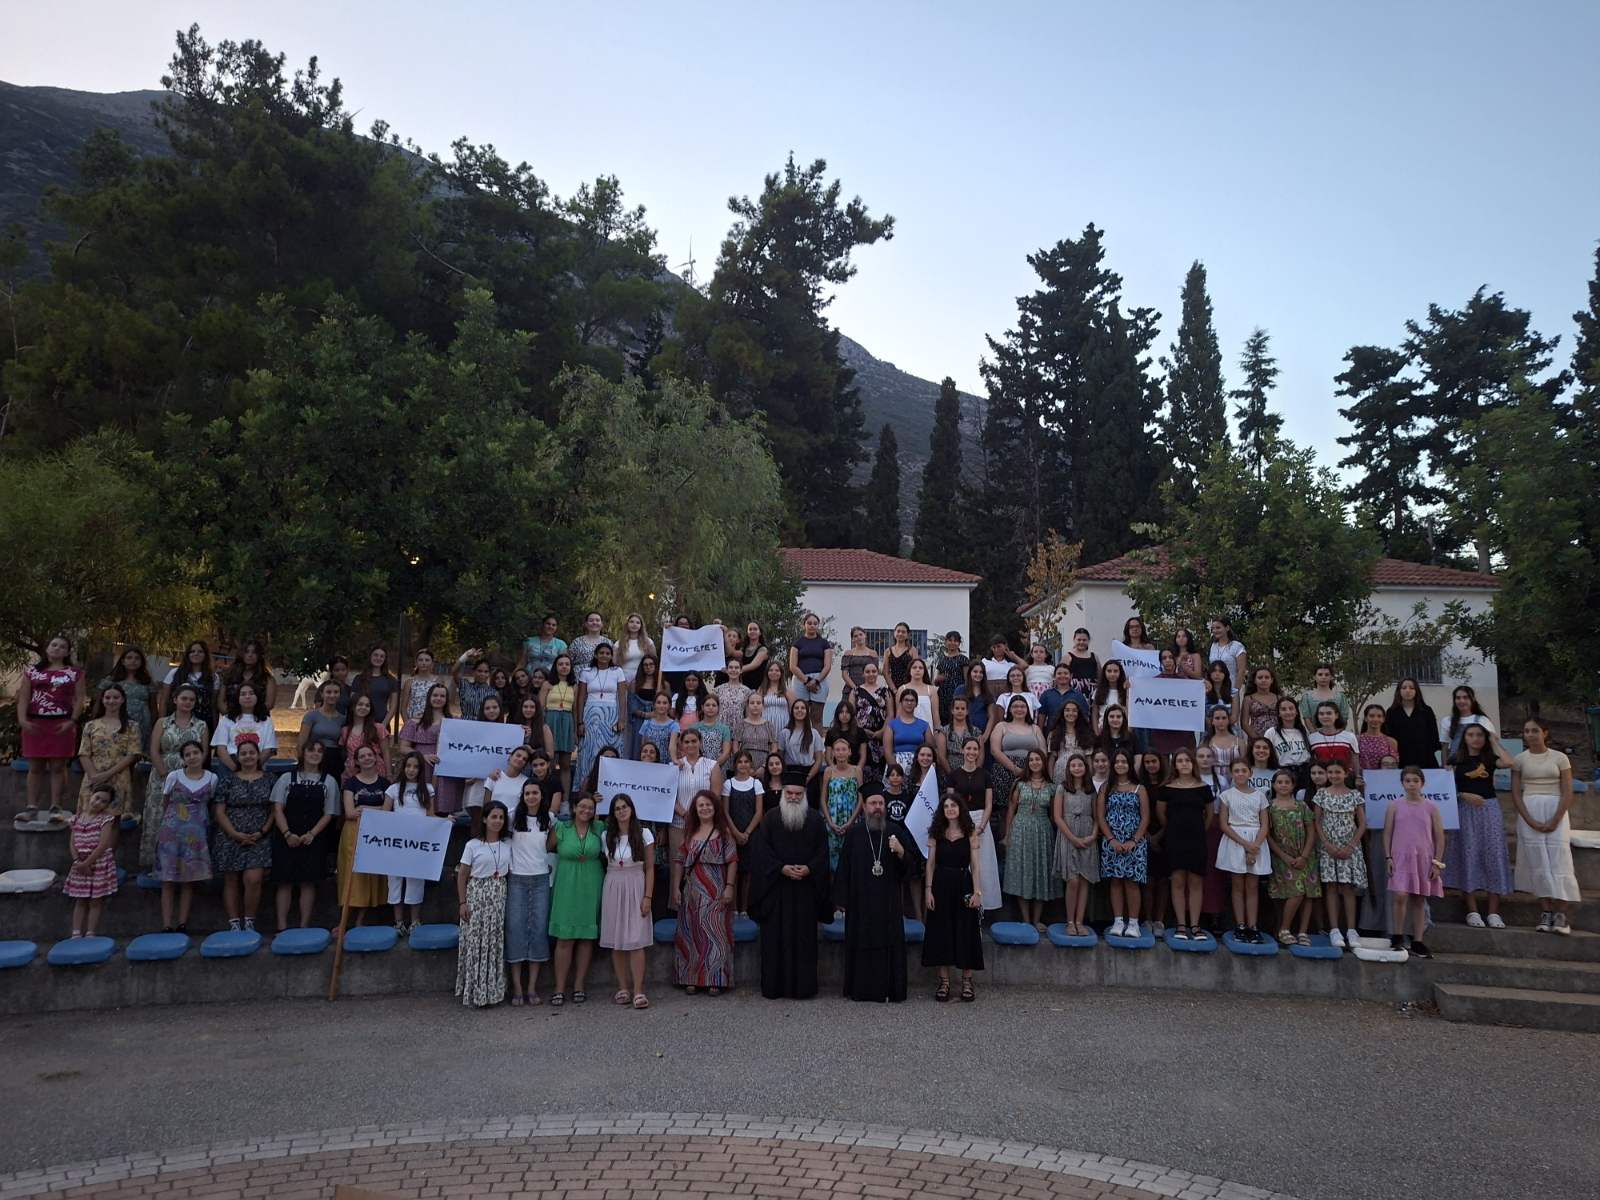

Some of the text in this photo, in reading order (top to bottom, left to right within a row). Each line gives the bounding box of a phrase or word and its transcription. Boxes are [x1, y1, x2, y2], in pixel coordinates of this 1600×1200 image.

[1134, 697, 1199, 708] ΑΝΔΡΕΙΕΣ
[448, 742, 512, 755] ΚΡΑΤΑΙΕΣ
[891, 805, 904, 815] NY
[362, 834, 441, 852] ΤΑΠΕΙΝΕΣ
